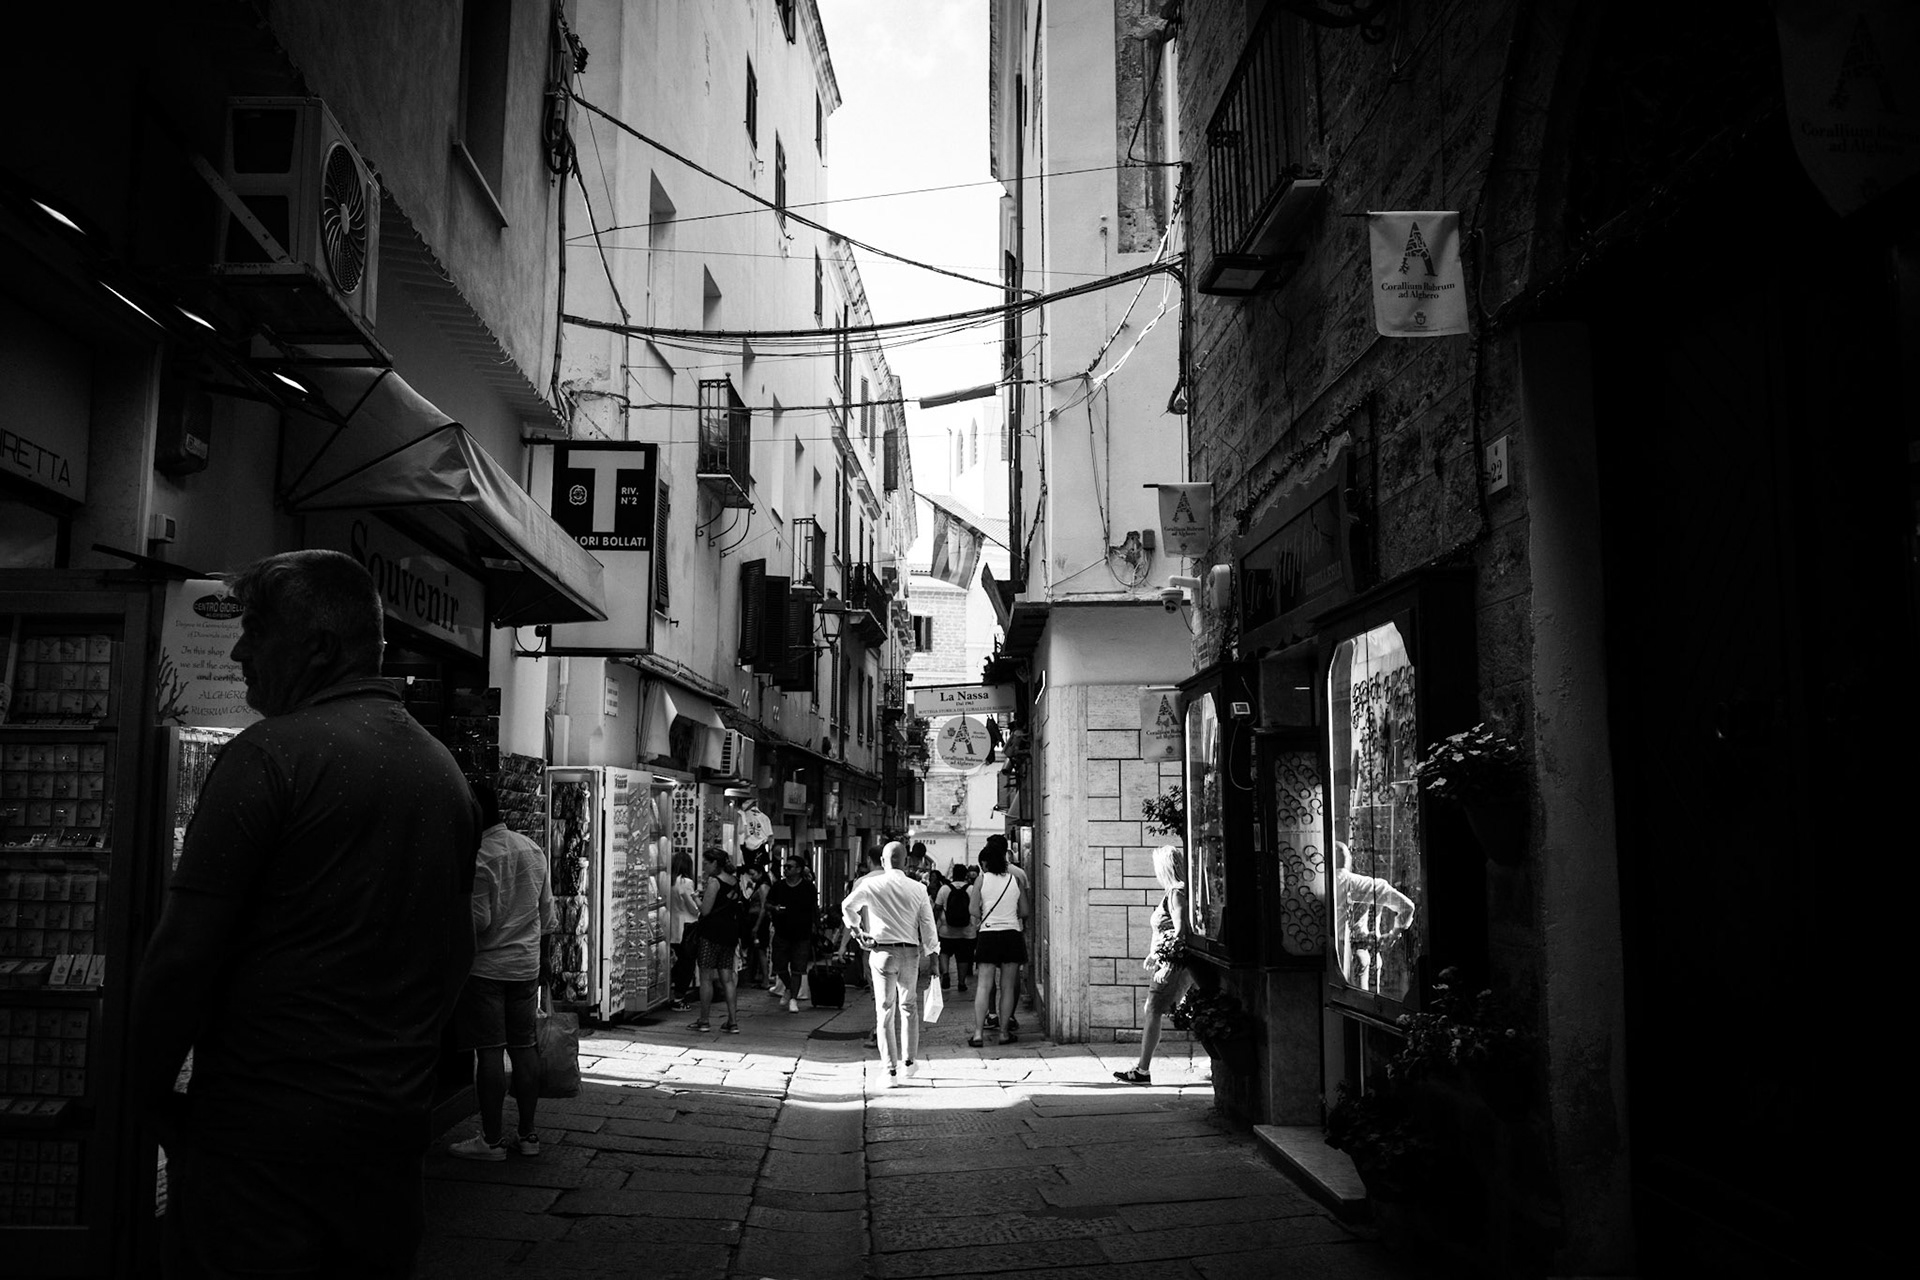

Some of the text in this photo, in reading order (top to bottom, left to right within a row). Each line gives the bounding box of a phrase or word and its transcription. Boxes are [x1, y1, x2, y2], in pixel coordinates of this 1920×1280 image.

[1381, 281, 1423, 291] Corallium
[1398, 290, 1439, 301] ad Alghero
[0, 428, 71, 488] RETTA
[568, 449, 646, 533] T
[621, 487, 639, 496] RIV.
[602, 536, 647, 547] BOLLATI
[351, 519, 459, 633] Souvenir
[193, 602, 219, 613] CENTRO
[207, 646, 225, 658] shop
[192, 660, 205, 668] sell
[206, 660, 218, 669] the
[196, 672, 212, 681] and
[198, 690, 246, 700] ALGHERO
[940, 691, 989, 702] La Nassa
